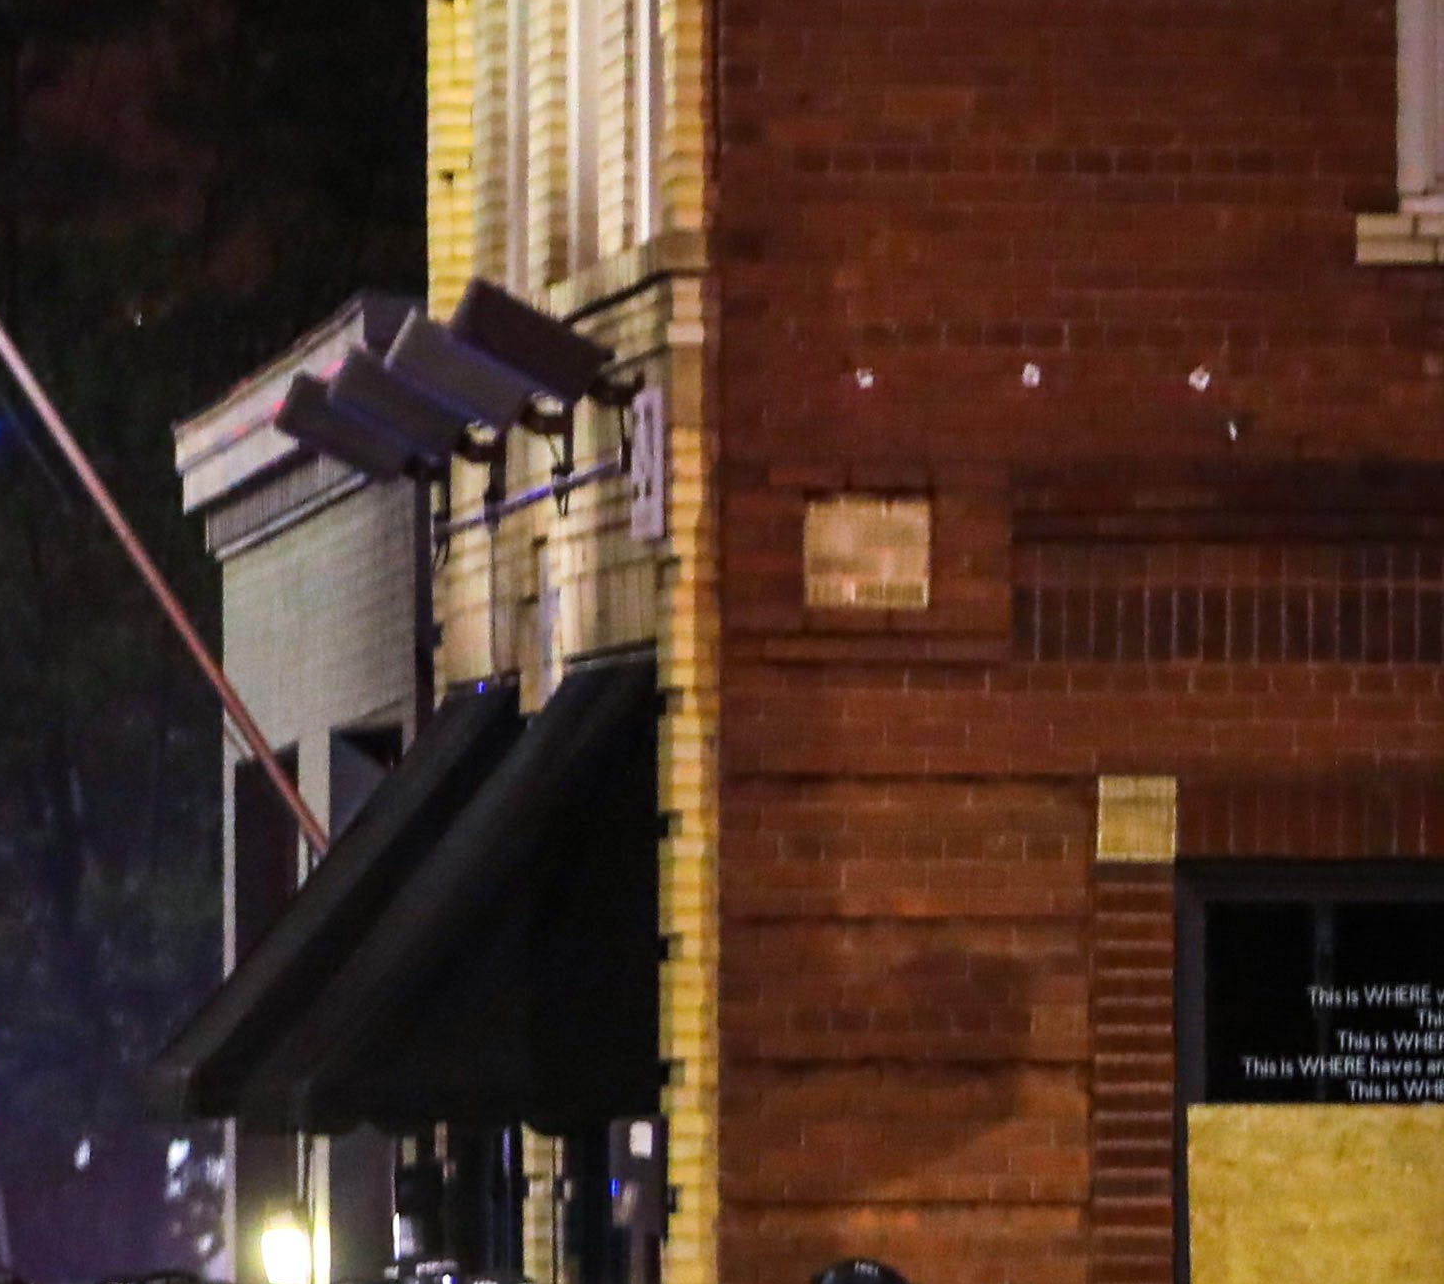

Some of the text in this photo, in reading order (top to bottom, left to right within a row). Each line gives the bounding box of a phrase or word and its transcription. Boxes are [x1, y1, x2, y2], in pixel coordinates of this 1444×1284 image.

[1308, 985, 1342, 1007] This
[1346, 986, 1359, 1007] is
[1364, 983, 1431, 1006] WHERE
[1418, 1009, 1444, 1028] Thi
[1338, 1030, 1370, 1052] This
[1375, 1031, 1388, 1051] is
[1243, 1055, 1277, 1078] This
[1281, 1057, 1294, 1078] is
[1299, 1055, 1366, 1077] WHERE
[1348, 1080, 1382, 1100] This
[1385, 1081, 1399, 1100] is
